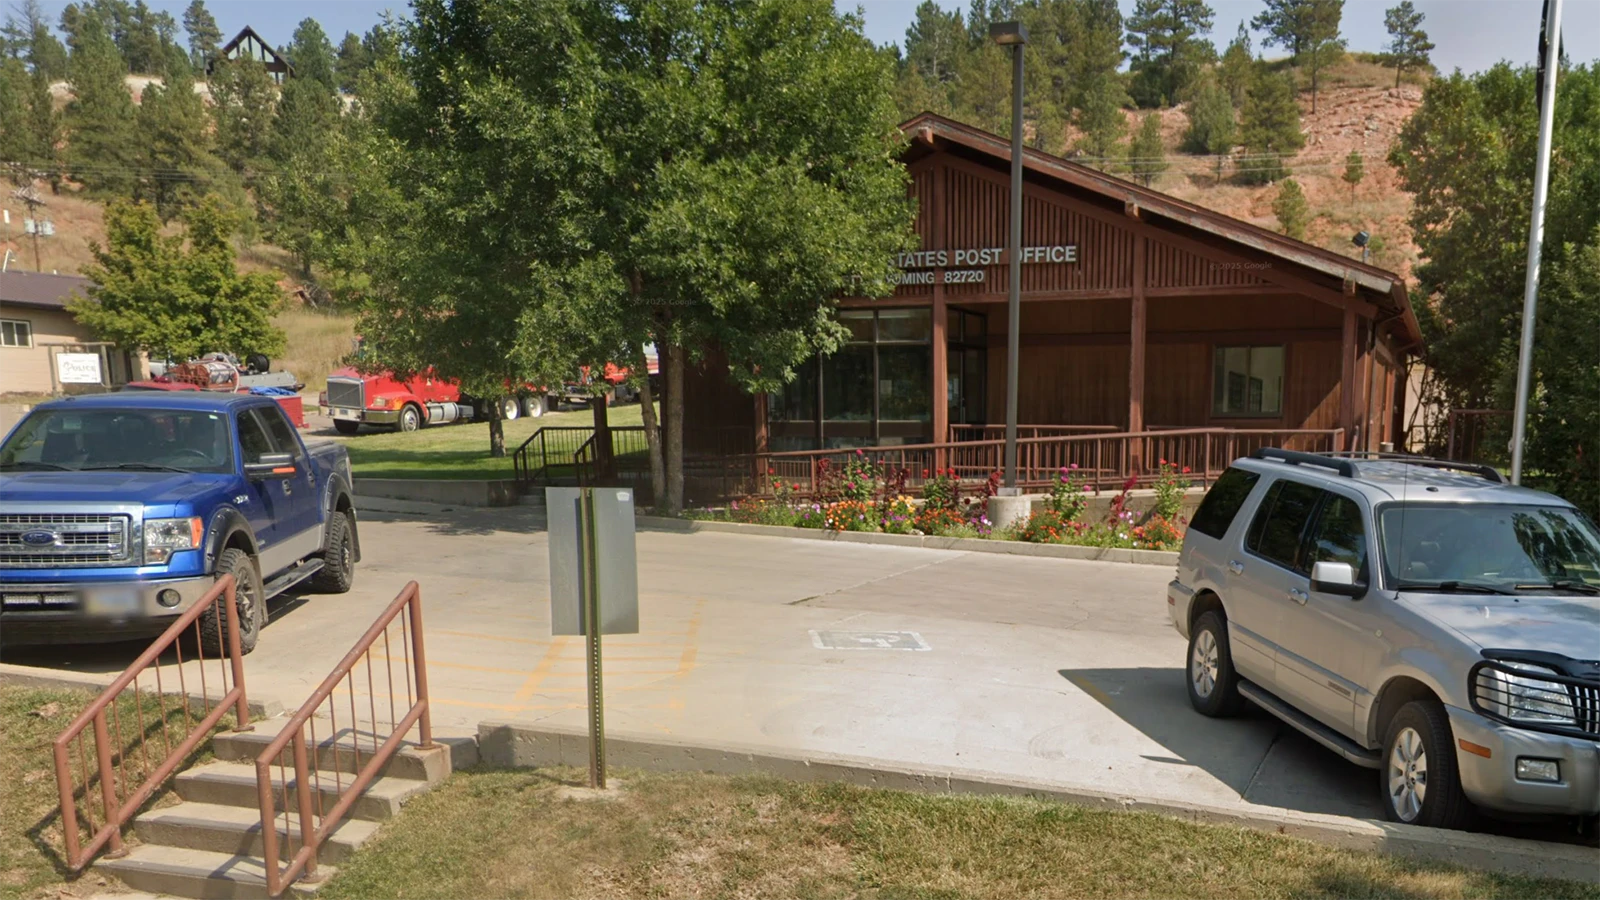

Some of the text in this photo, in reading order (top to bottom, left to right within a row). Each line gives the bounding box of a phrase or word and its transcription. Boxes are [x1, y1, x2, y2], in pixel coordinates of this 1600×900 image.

[955, 249, 1003, 266] POST
[1019, 245, 1077, 263] FFICE
[885, 270, 984, 285] YOMING 82720
